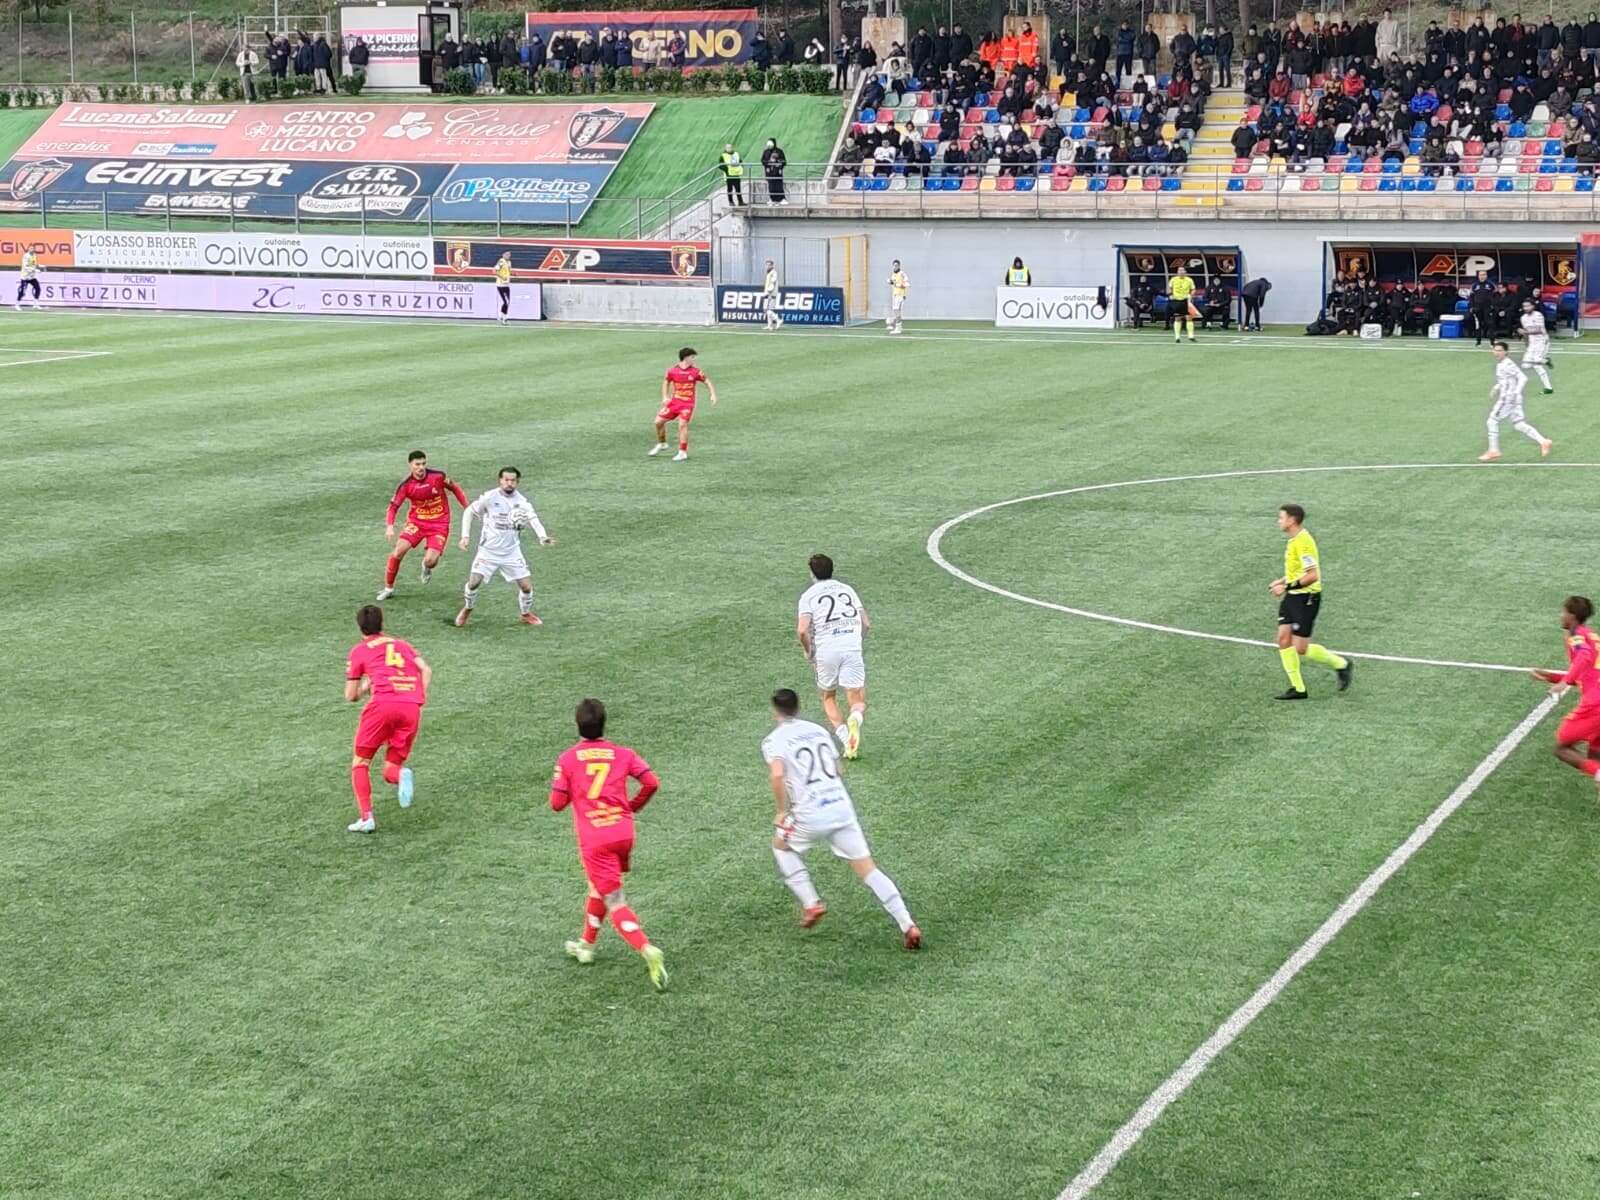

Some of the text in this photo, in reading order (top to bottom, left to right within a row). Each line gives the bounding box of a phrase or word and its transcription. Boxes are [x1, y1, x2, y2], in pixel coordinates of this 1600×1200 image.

[375, 33, 418, 44] PICERNO
[368, 43, 419, 52] eonessa
[283, 111, 375, 124] CENTRO
[272, 124, 366, 138] MEDICO
[259, 138, 357, 152] LUCANO
[346, 168, 399, 182] G.R.
[318, 183, 407, 196] SALUMI
[494, 177, 591, 193] Officine
[1, 243, 72, 254] GIVOVA
[89, 235, 197, 249] LOSASSO BROKER
[264, 238, 302, 246] autolinee
[382, 240, 421, 249] autolinee
[204, 241, 309, 267] Caivano
[321, 244, 428, 270] Caivano
[123, 275, 156, 284] PICERNO
[46, 285, 156, 301] STRUZIONI
[438, 283, 474, 292] PICERNO
[321, 292, 474, 309] COSTRUZIONI
[814, 292, 841, 312] live
[1002, 297, 1107, 321] Caivano
[817, 592, 858, 623] 23
[385, 643, 405, 668] 4
[795, 742, 841, 786] 20
[585, 762, 611, 800] 7
